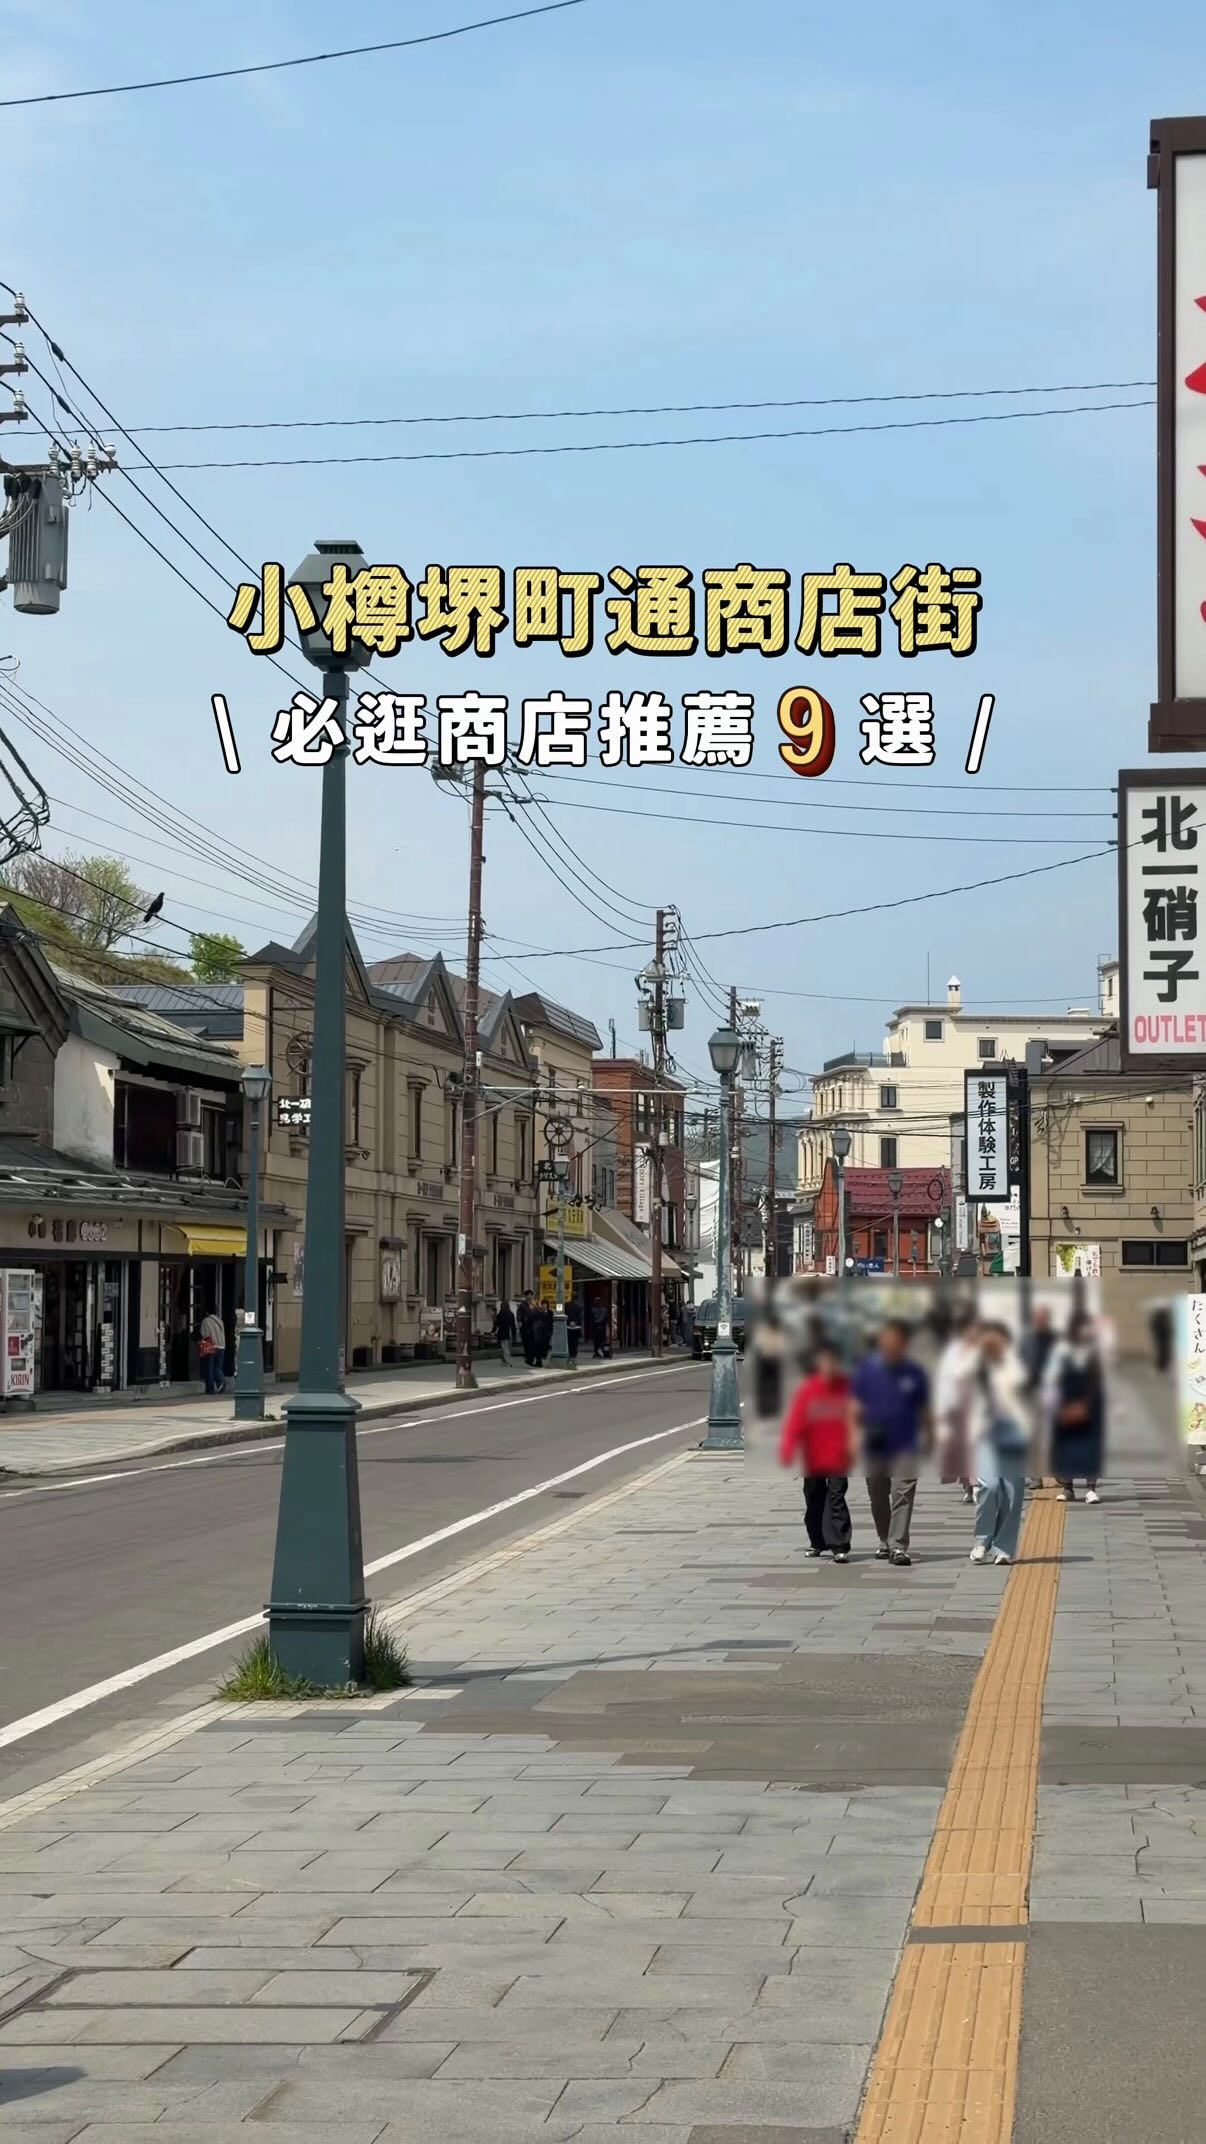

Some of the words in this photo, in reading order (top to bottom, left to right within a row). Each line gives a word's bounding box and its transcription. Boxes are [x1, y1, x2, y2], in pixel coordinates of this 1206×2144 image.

[1140, 795, 1200, 1003] 北一硝子
[1134, 1014, 1206, 1044] OUTLET
[977, 1080, 997, 1191] 製作体験工房
[10, 1373, 30, 1387] KIRIN
